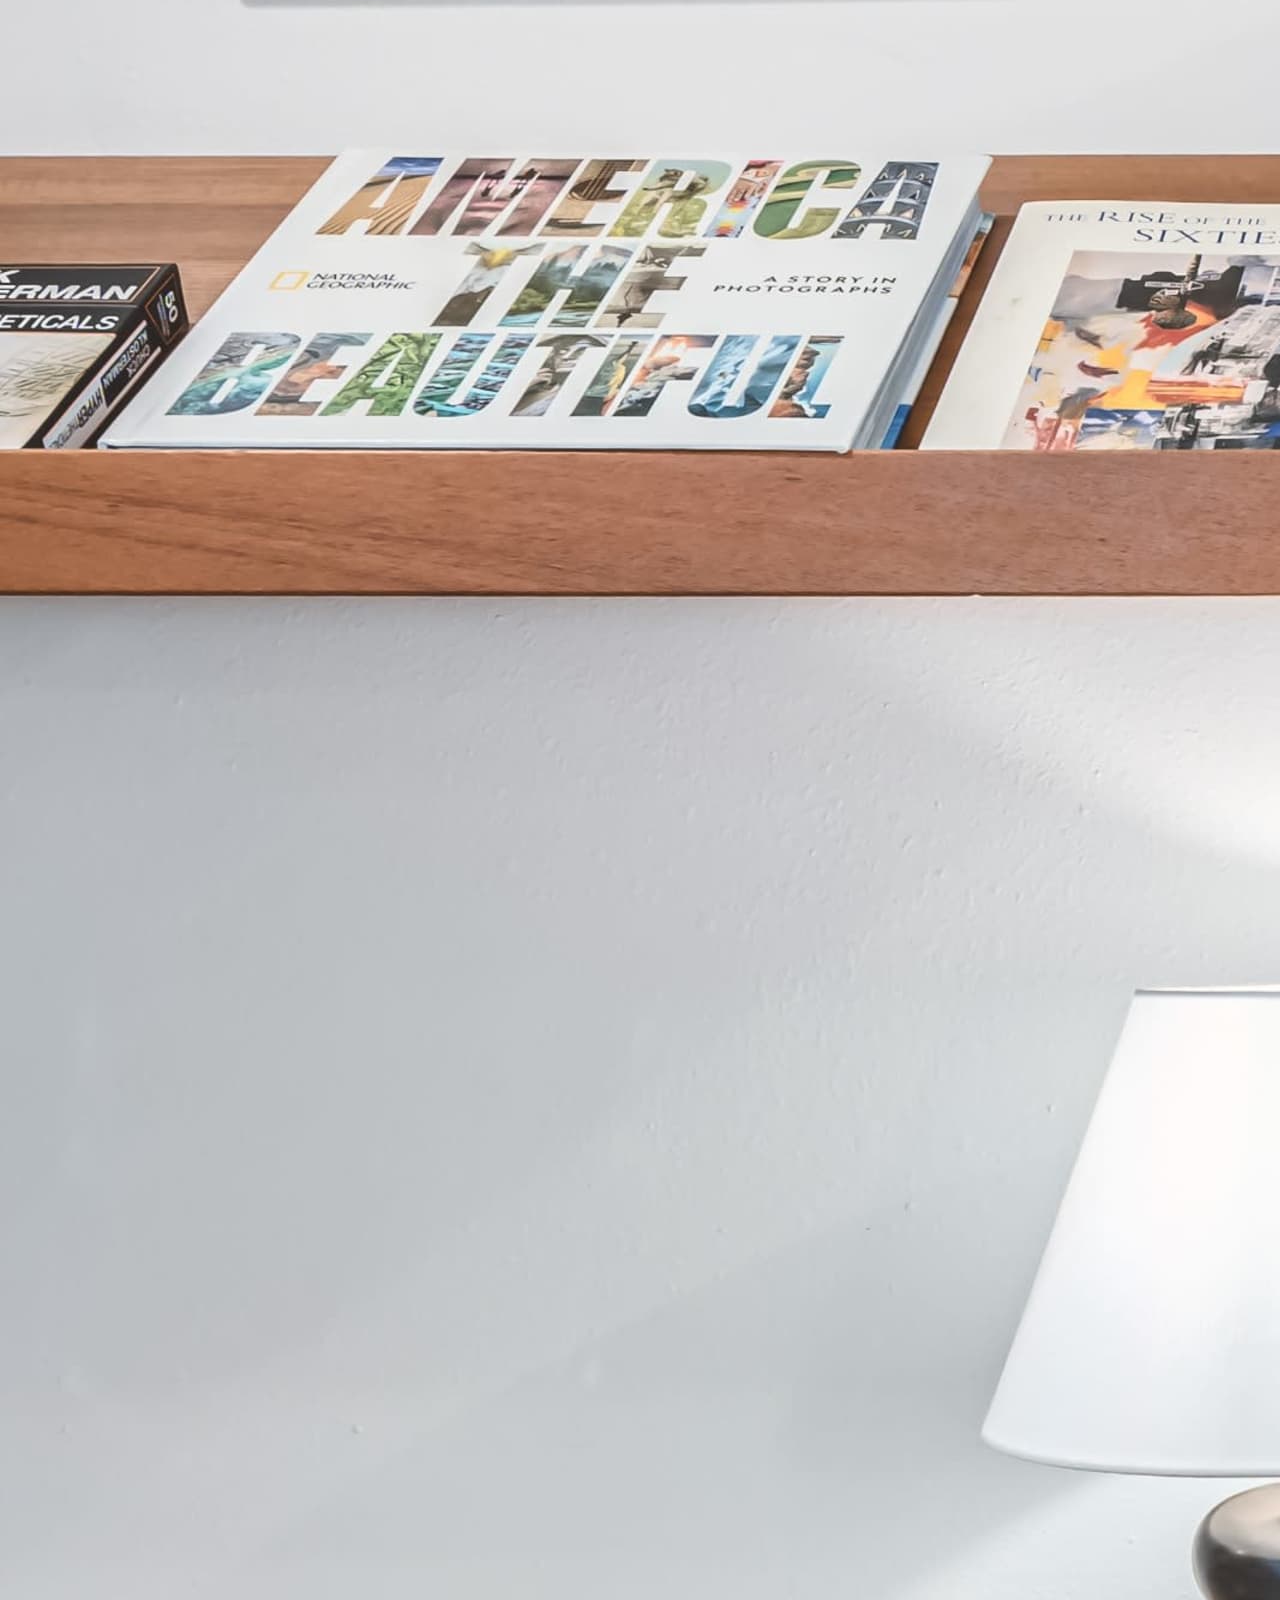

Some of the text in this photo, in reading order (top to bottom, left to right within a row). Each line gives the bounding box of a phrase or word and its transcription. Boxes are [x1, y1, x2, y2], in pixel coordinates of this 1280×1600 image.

[315, 157, 940, 240] AMERICA
[1047, 213, 1088, 222] THE
[1098, 211, 1178, 224] RISE
[1221, 217, 1267, 225] THE
[307, 280, 416, 289] GEOGRAPHIC
[431, 242, 707, 328] THE
[787, 276, 864, 284] STORY
[713, 285, 892, 294] PHOTOGRAPHS
[166, 332, 845, 417] BEAUTIFUL
